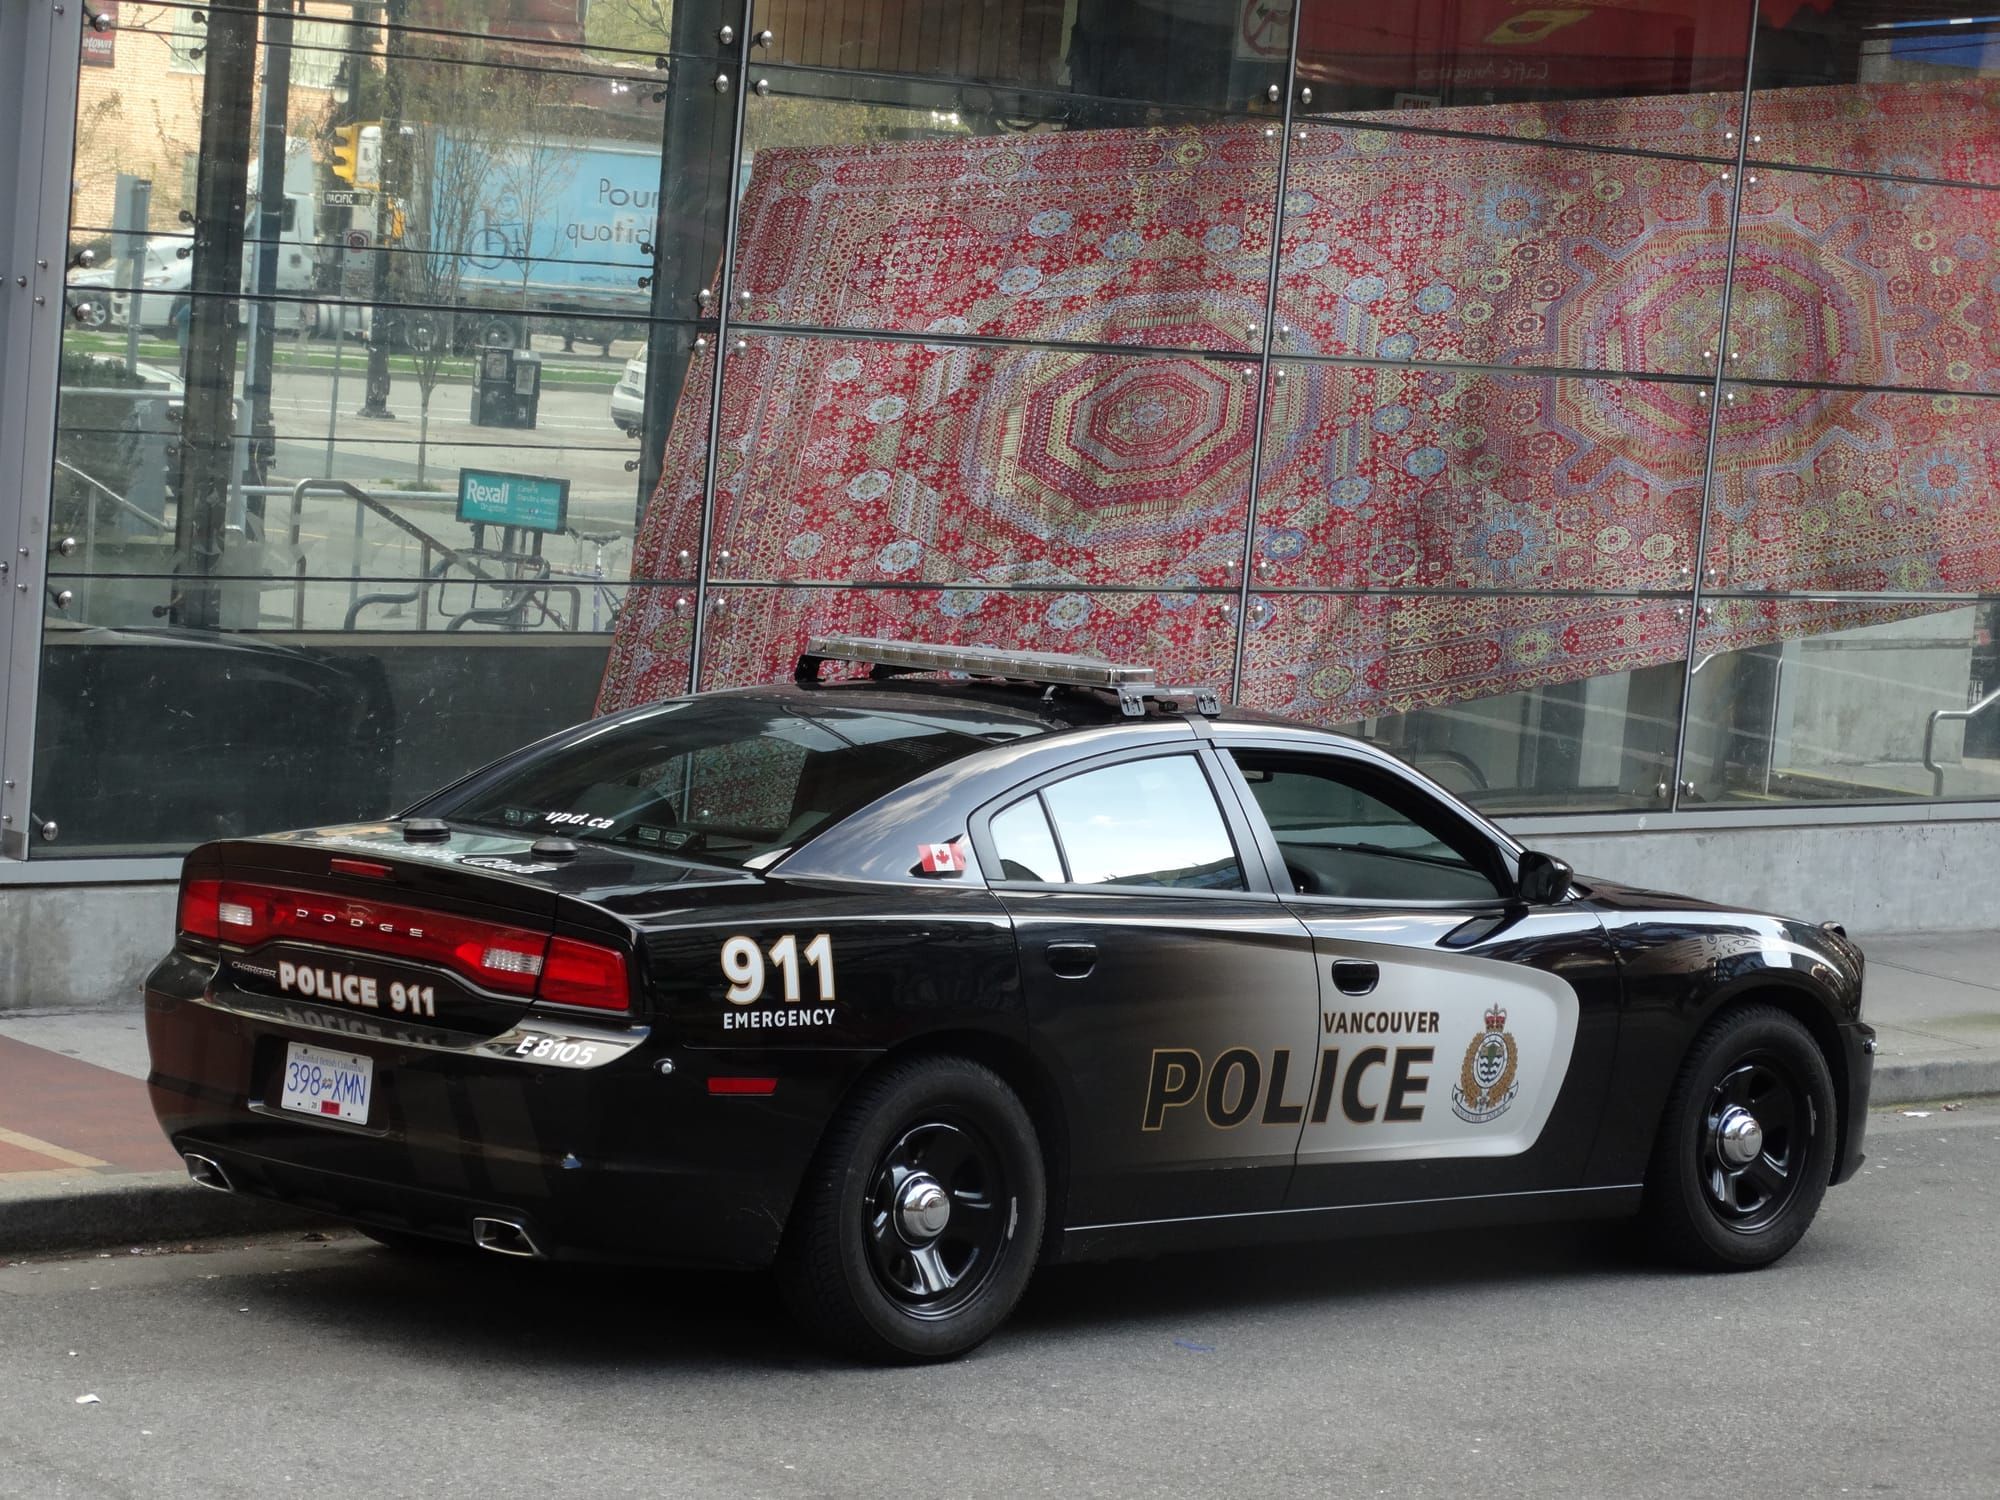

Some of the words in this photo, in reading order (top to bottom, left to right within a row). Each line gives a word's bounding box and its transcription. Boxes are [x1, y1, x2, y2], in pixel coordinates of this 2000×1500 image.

[325, 192, 353, 204] PACIFIC
[466, 478, 509, 505] Rexall
[545, 811, 615, 829] vpd.ca
[296, 908, 424, 938] DODGE
[231, 960, 277, 979] CHARGER
[721, 934, 836, 1005] 911
[279, 960, 378, 1008] POLICE
[390, 981, 435, 1017] 911
[723, 1009, 836, 1030] EMERGENCY
[1323, 1011, 1440, 1034] VANCOUVER
[515, 1035, 597, 1066] E8105
[287, 1062, 322, 1096] 398
[331, 1069, 367, 1106] XMN
[1141, 1046, 1435, 1131] POLICE
